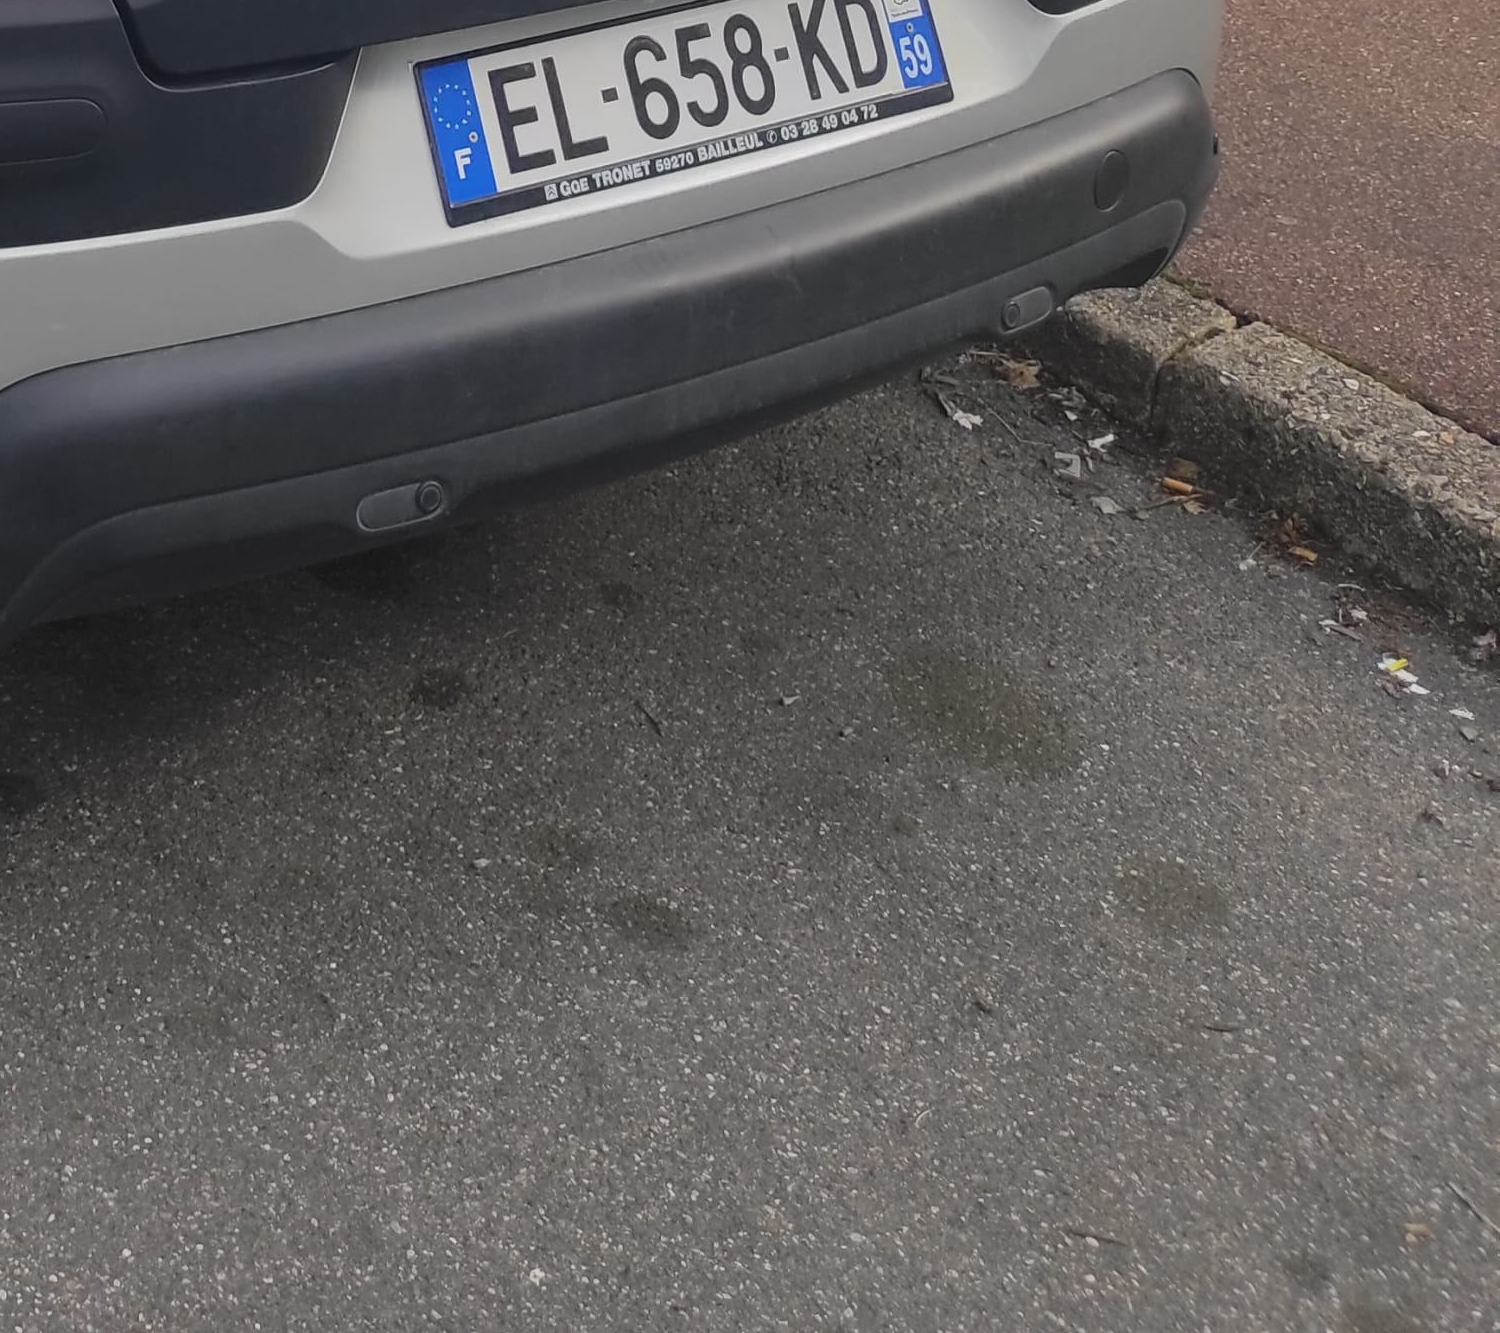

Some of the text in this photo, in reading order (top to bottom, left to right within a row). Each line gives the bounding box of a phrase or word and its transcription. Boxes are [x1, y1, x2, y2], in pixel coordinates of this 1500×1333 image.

[898, 33, 933, 79] 59
[453, 147, 473, 181] F
[592, 159, 652, 190] TRONET
[655, 151, 695, 174] 59270
[697, 133, 764, 162] BAILLEUL
[780, 126, 798, 141] 03
[801, 119, 819, 135] 28
[822, 113, 838, 130] 49
[841, 108, 859, 125] 04
[860, 103, 878, 120] 72
